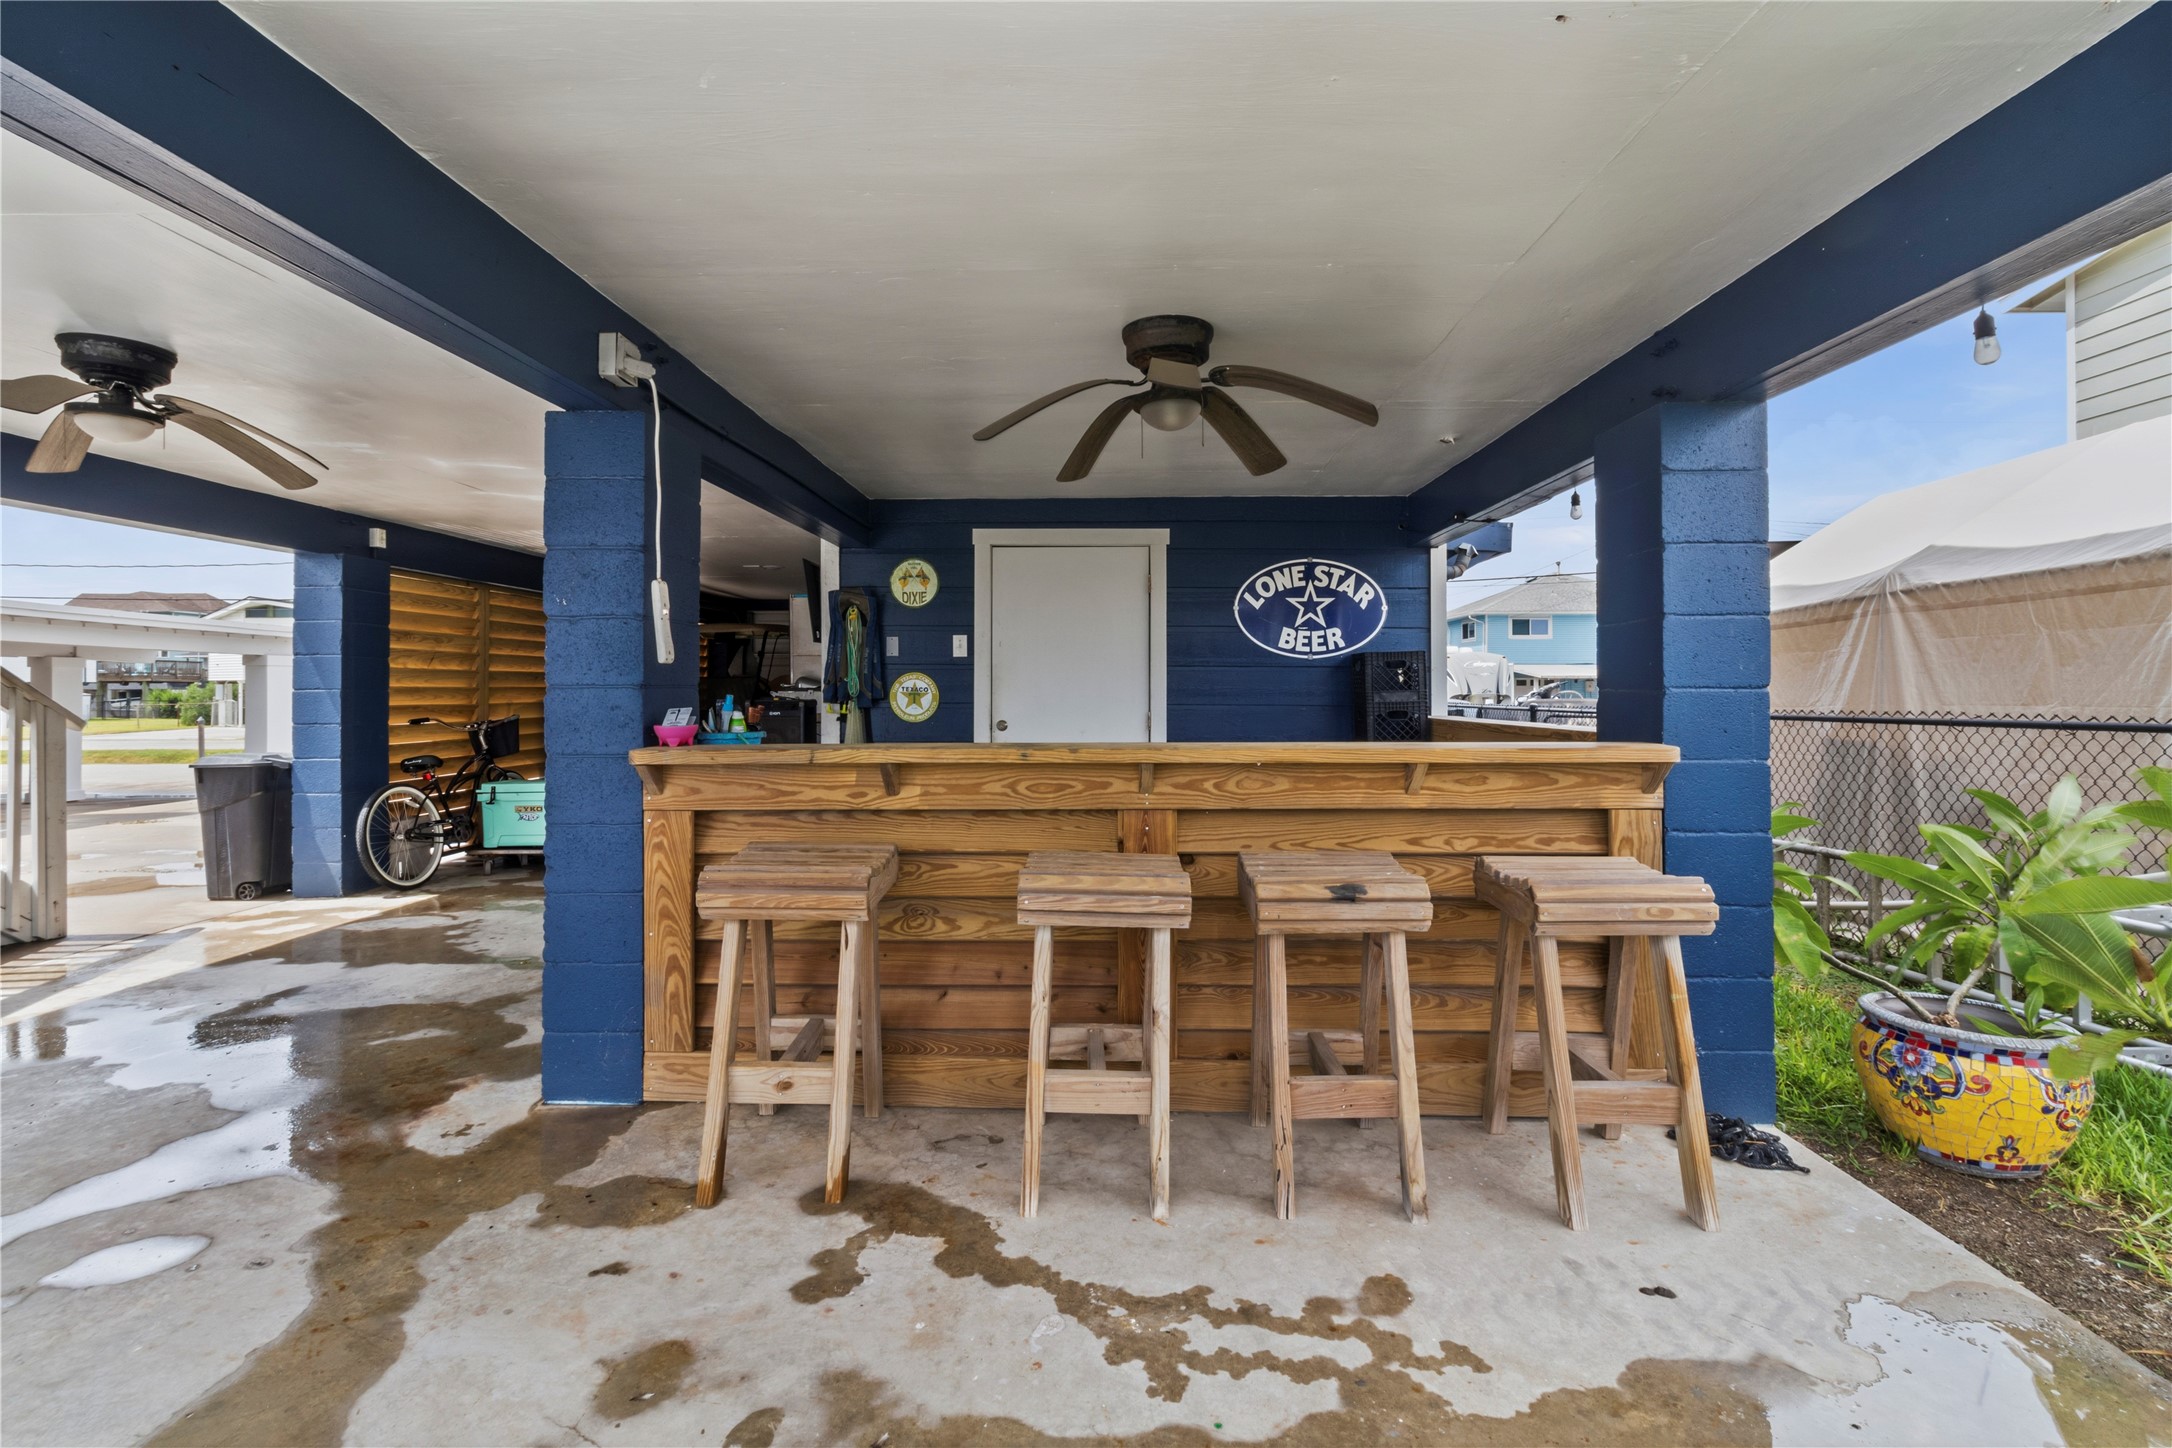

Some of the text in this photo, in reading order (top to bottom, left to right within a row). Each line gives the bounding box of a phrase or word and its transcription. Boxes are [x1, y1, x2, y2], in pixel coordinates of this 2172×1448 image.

[902, 591, 928, 605] DIXIE
[1243, 565, 1375, 610] LONE STAR
[1278, 627, 1346, 652] BEER
